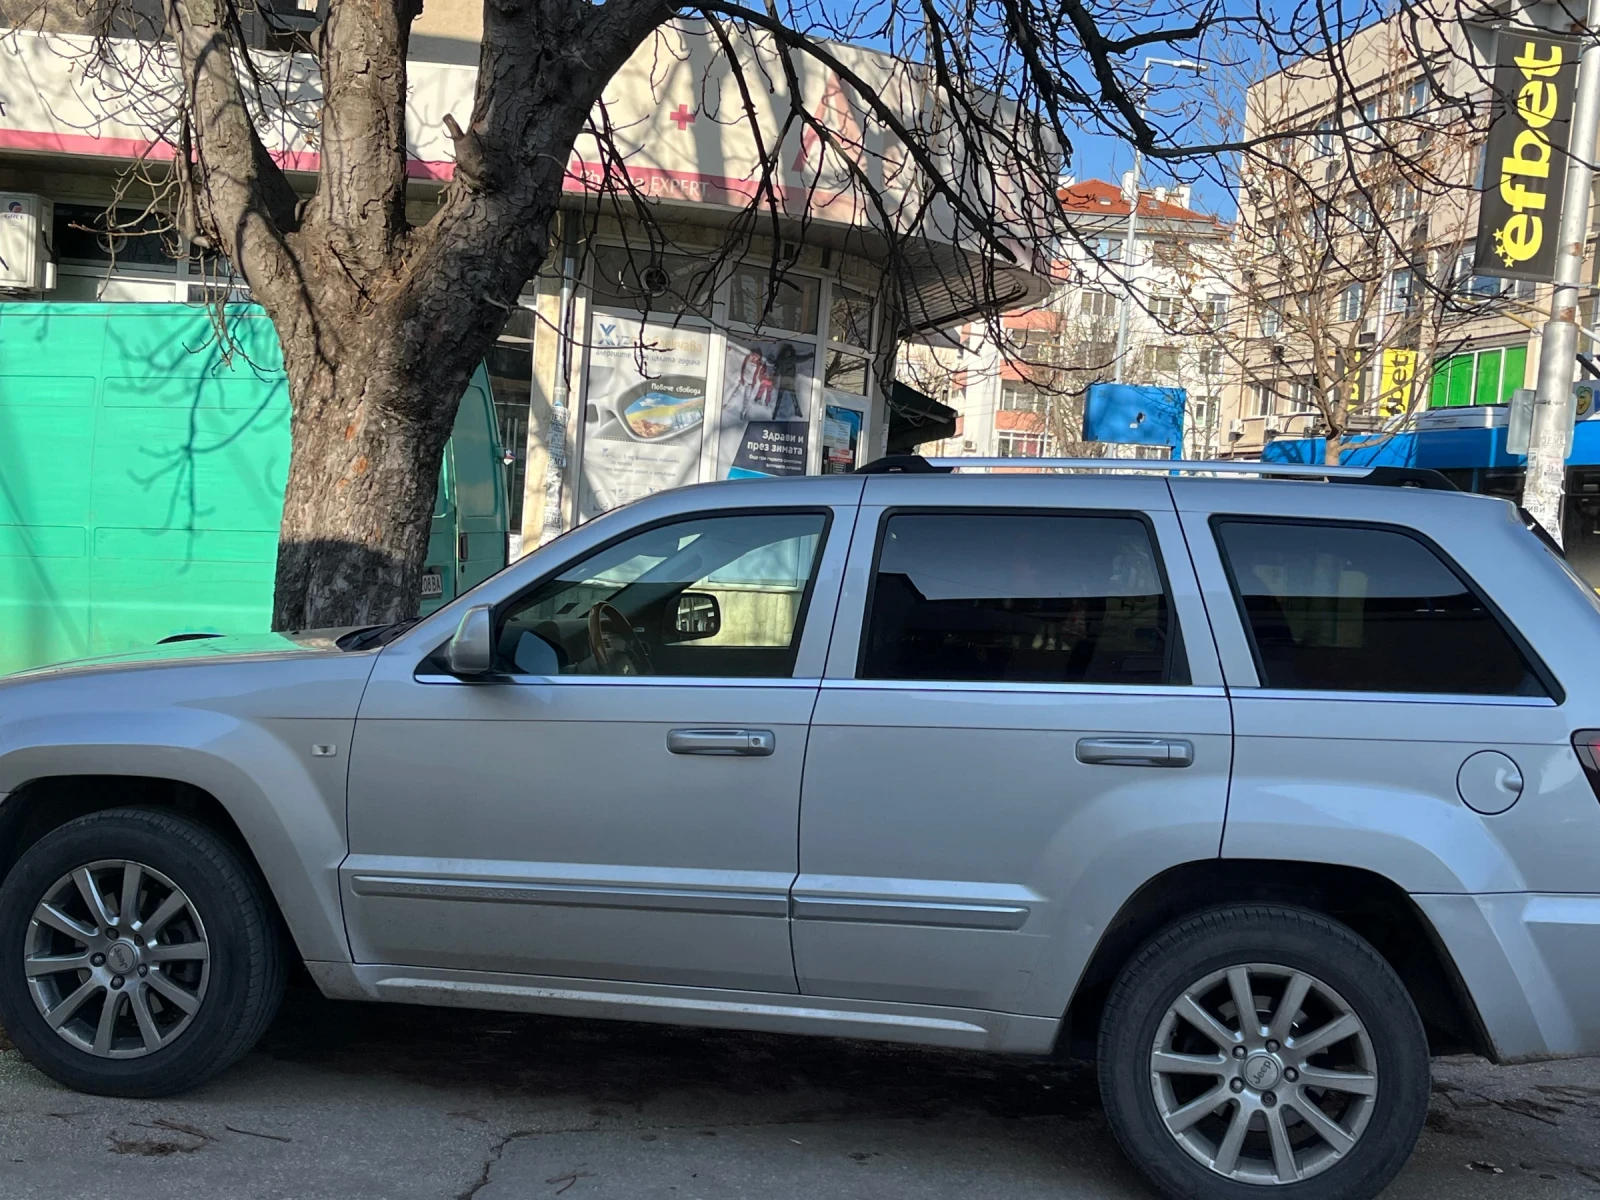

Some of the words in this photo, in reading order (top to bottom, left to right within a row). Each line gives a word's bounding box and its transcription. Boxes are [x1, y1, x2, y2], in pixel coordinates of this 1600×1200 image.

[1500, 41, 1562, 261] efbet
[651, 176, 710, 197] EXPERT
[762, 429, 796, 443] Здрави
[797, 435, 804, 444] и
[747, 441, 769, 452] през
[771, 444, 803, 456] зимата
[1253, 1060, 1271, 1084] Jeep
